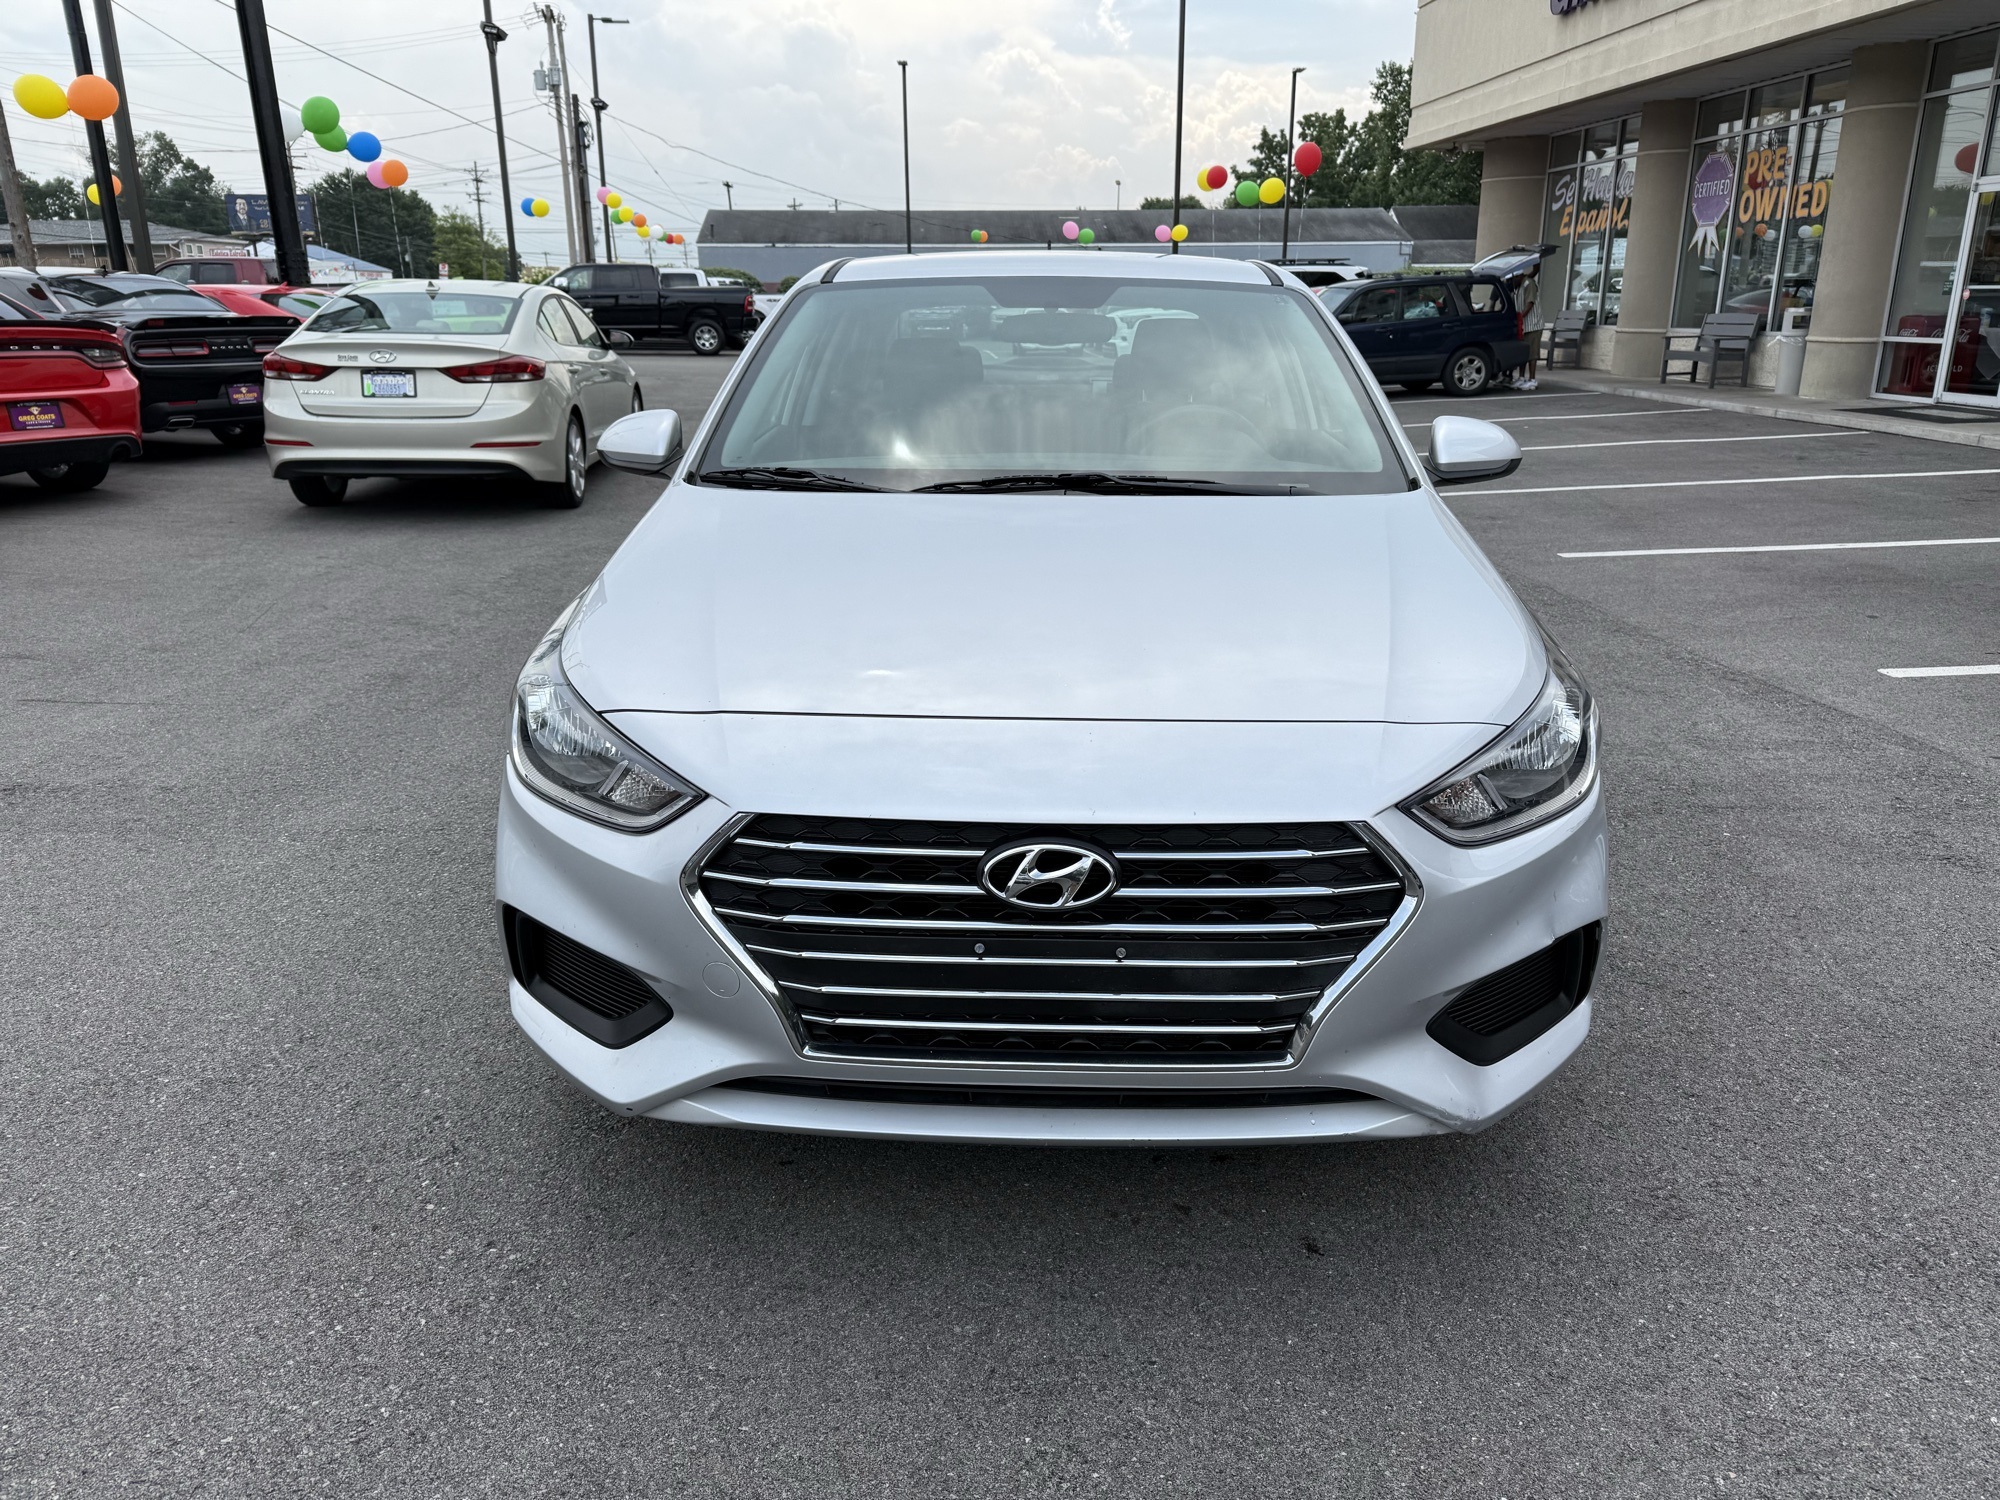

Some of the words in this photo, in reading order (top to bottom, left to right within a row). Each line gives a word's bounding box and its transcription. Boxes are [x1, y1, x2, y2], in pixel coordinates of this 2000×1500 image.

[1743, 146, 1792, 184] PRE-
[1552, 174, 1577, 211] Se
[1694, 179, 1731, 199] CERTIFIED
[1739, 182, 1827, 223] OWNED
